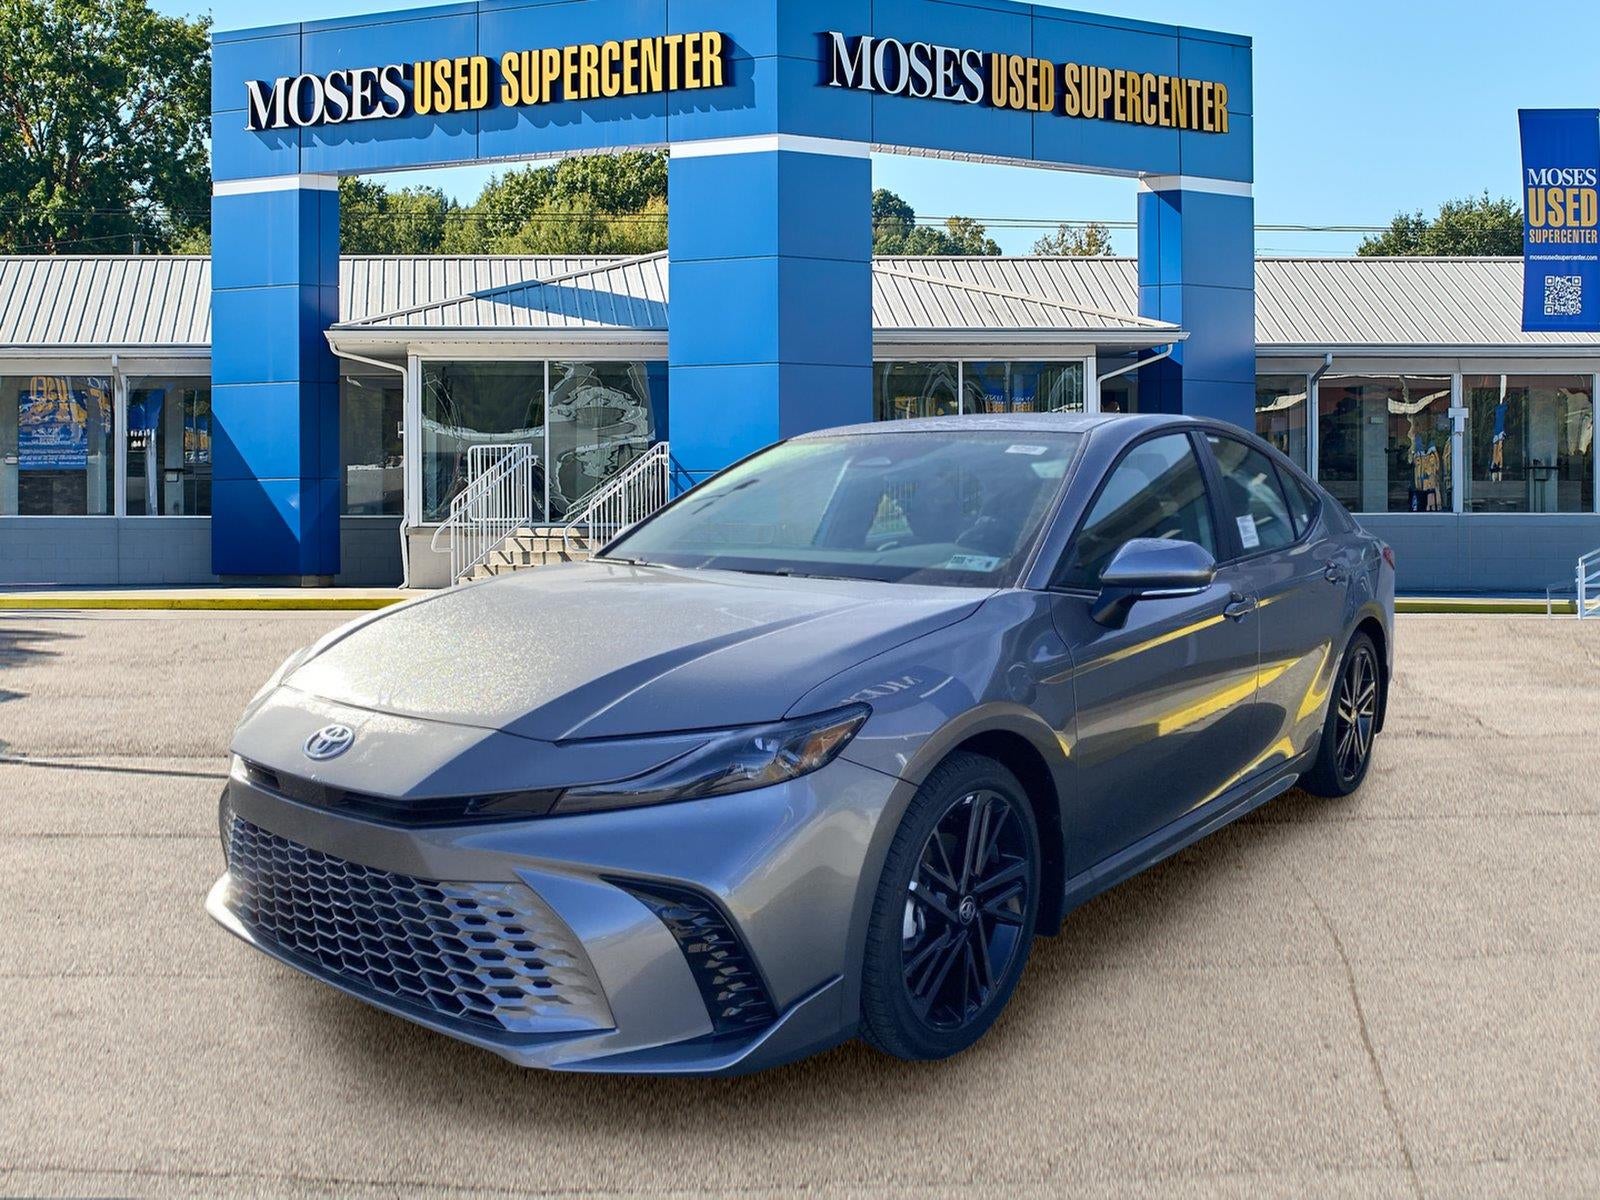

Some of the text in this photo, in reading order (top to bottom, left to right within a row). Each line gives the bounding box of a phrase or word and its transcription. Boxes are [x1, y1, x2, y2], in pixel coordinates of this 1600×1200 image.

[244, 31, 724, 132] MOSES USED SUPERCENTER
[827, 30, 1229, 134] MOSES USED SUPERCENTER
[1527, 168, 1597, 187] MOSES
[1528, 187, 1598, 228] USED
[1529, 229, 1598, 244] SUPERCENTER
